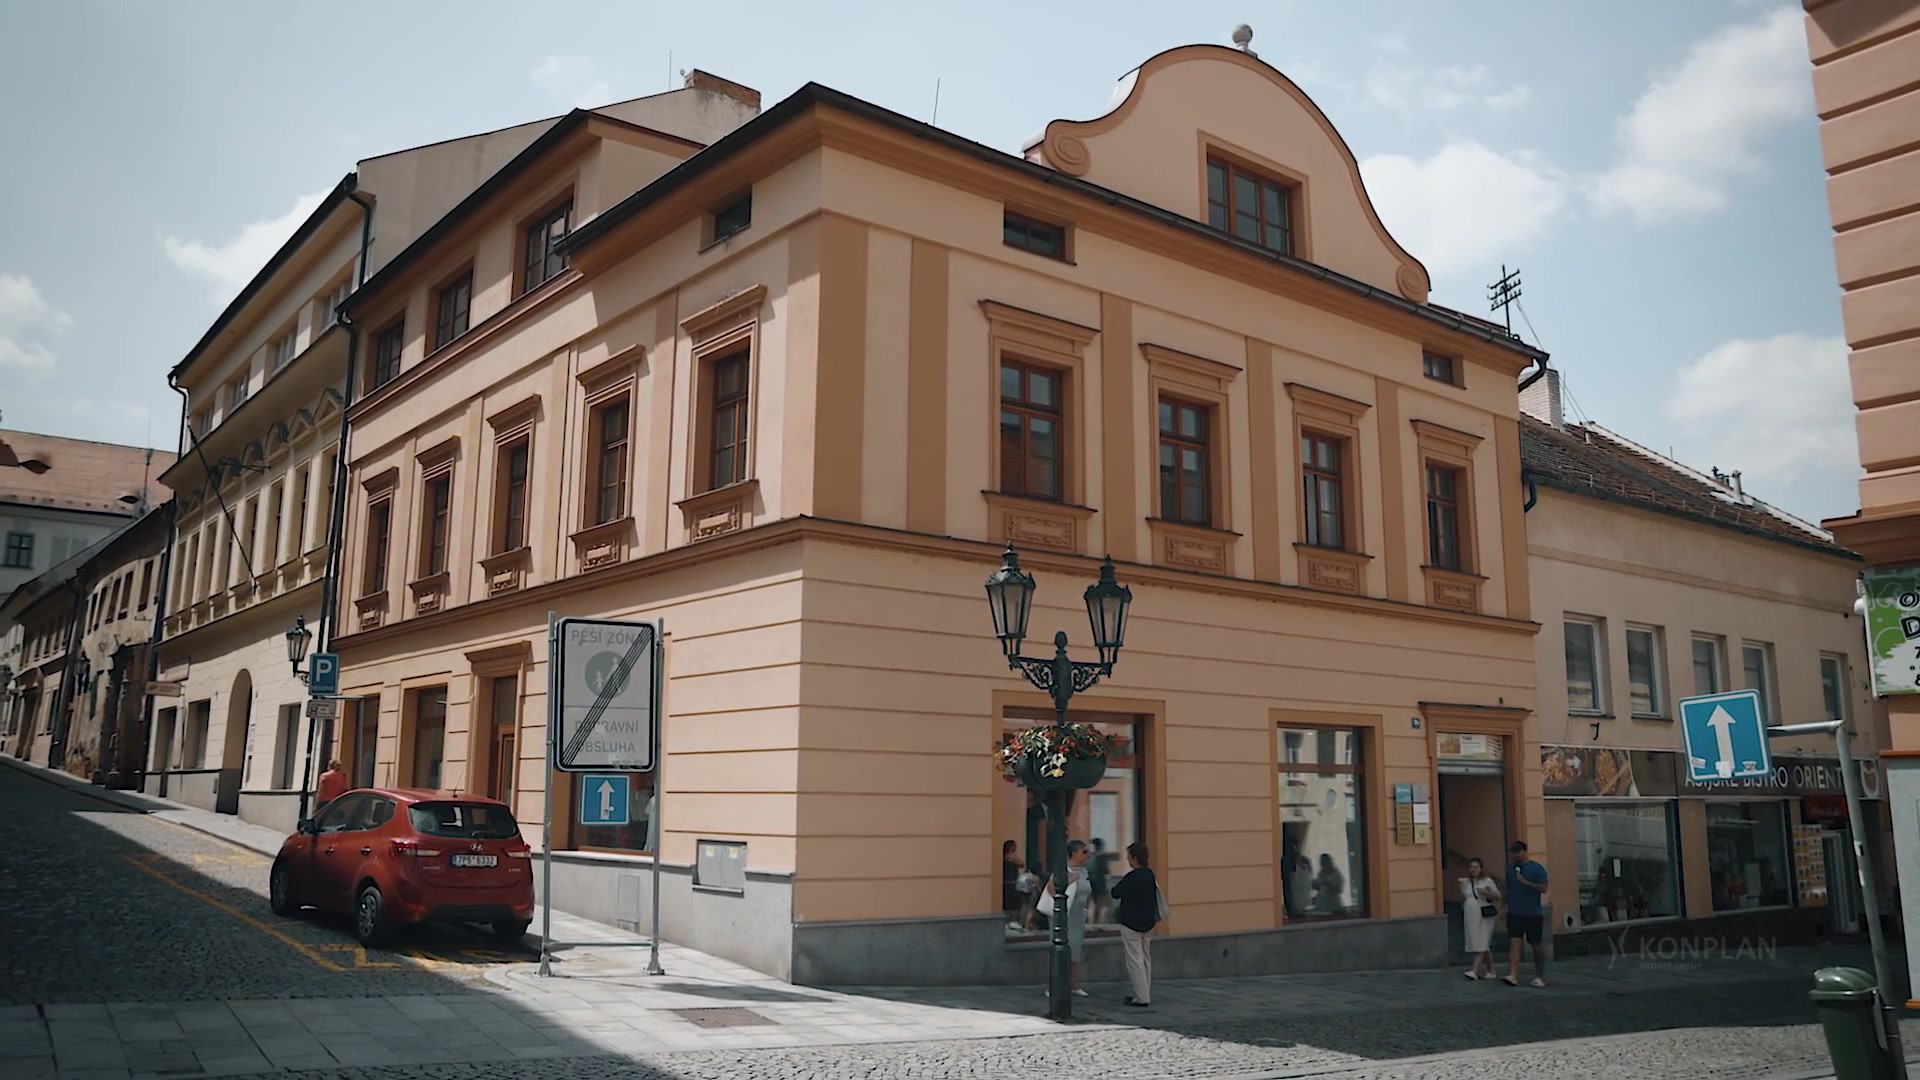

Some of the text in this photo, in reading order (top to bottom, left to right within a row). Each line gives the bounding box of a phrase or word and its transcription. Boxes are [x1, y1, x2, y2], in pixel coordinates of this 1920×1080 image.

[571, 627, 643, 646] PĚŠÍ ZÓN
[316, 659, 332, 682] P
[574, 719, 640, 733] DRAVNÍ
[1793, 765, 1843, 788] ORIENT
